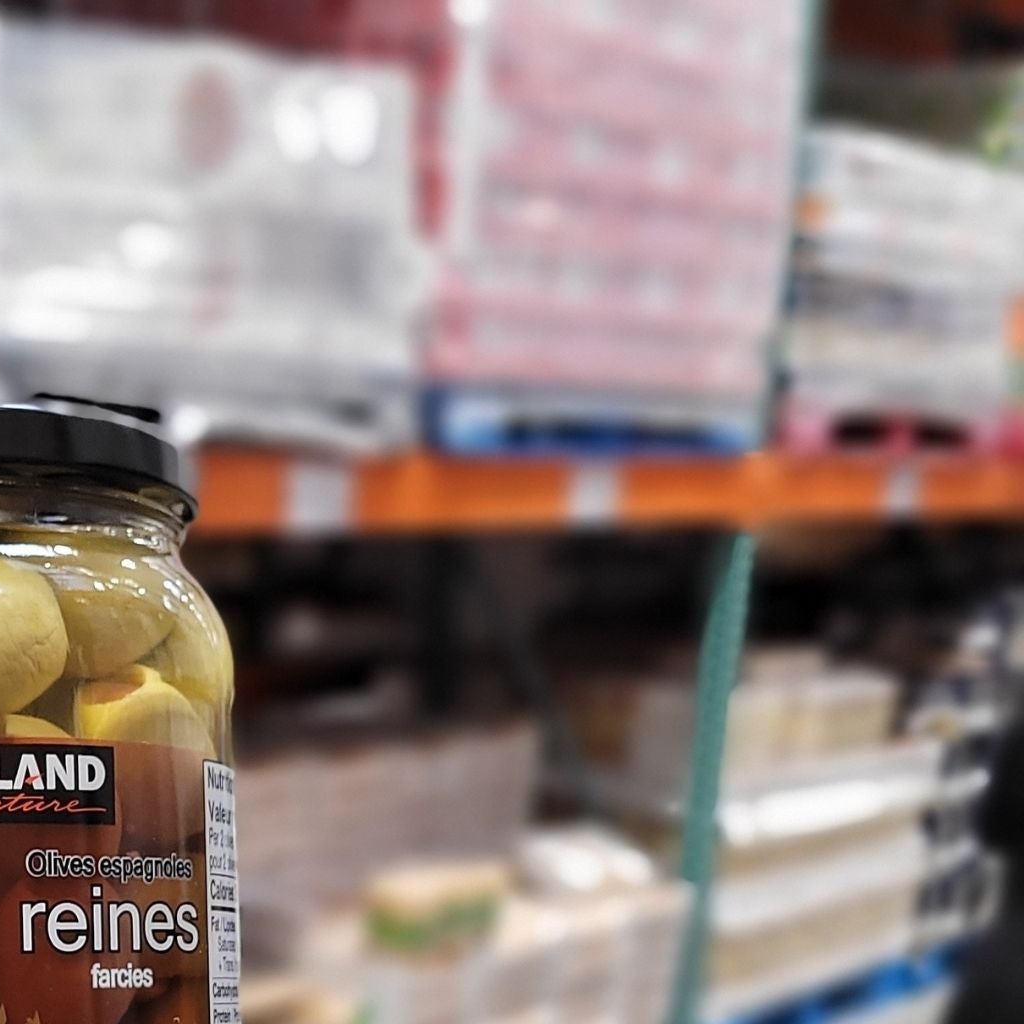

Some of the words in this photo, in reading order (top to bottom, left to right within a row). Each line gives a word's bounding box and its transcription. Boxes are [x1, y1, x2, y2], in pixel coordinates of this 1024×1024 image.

[26, 849, 95, 878] Olives
[99, 852, 193, 884] espagnoles
[21, 886, 199, 954] reines
[90, 962, 154, 990] farcies
